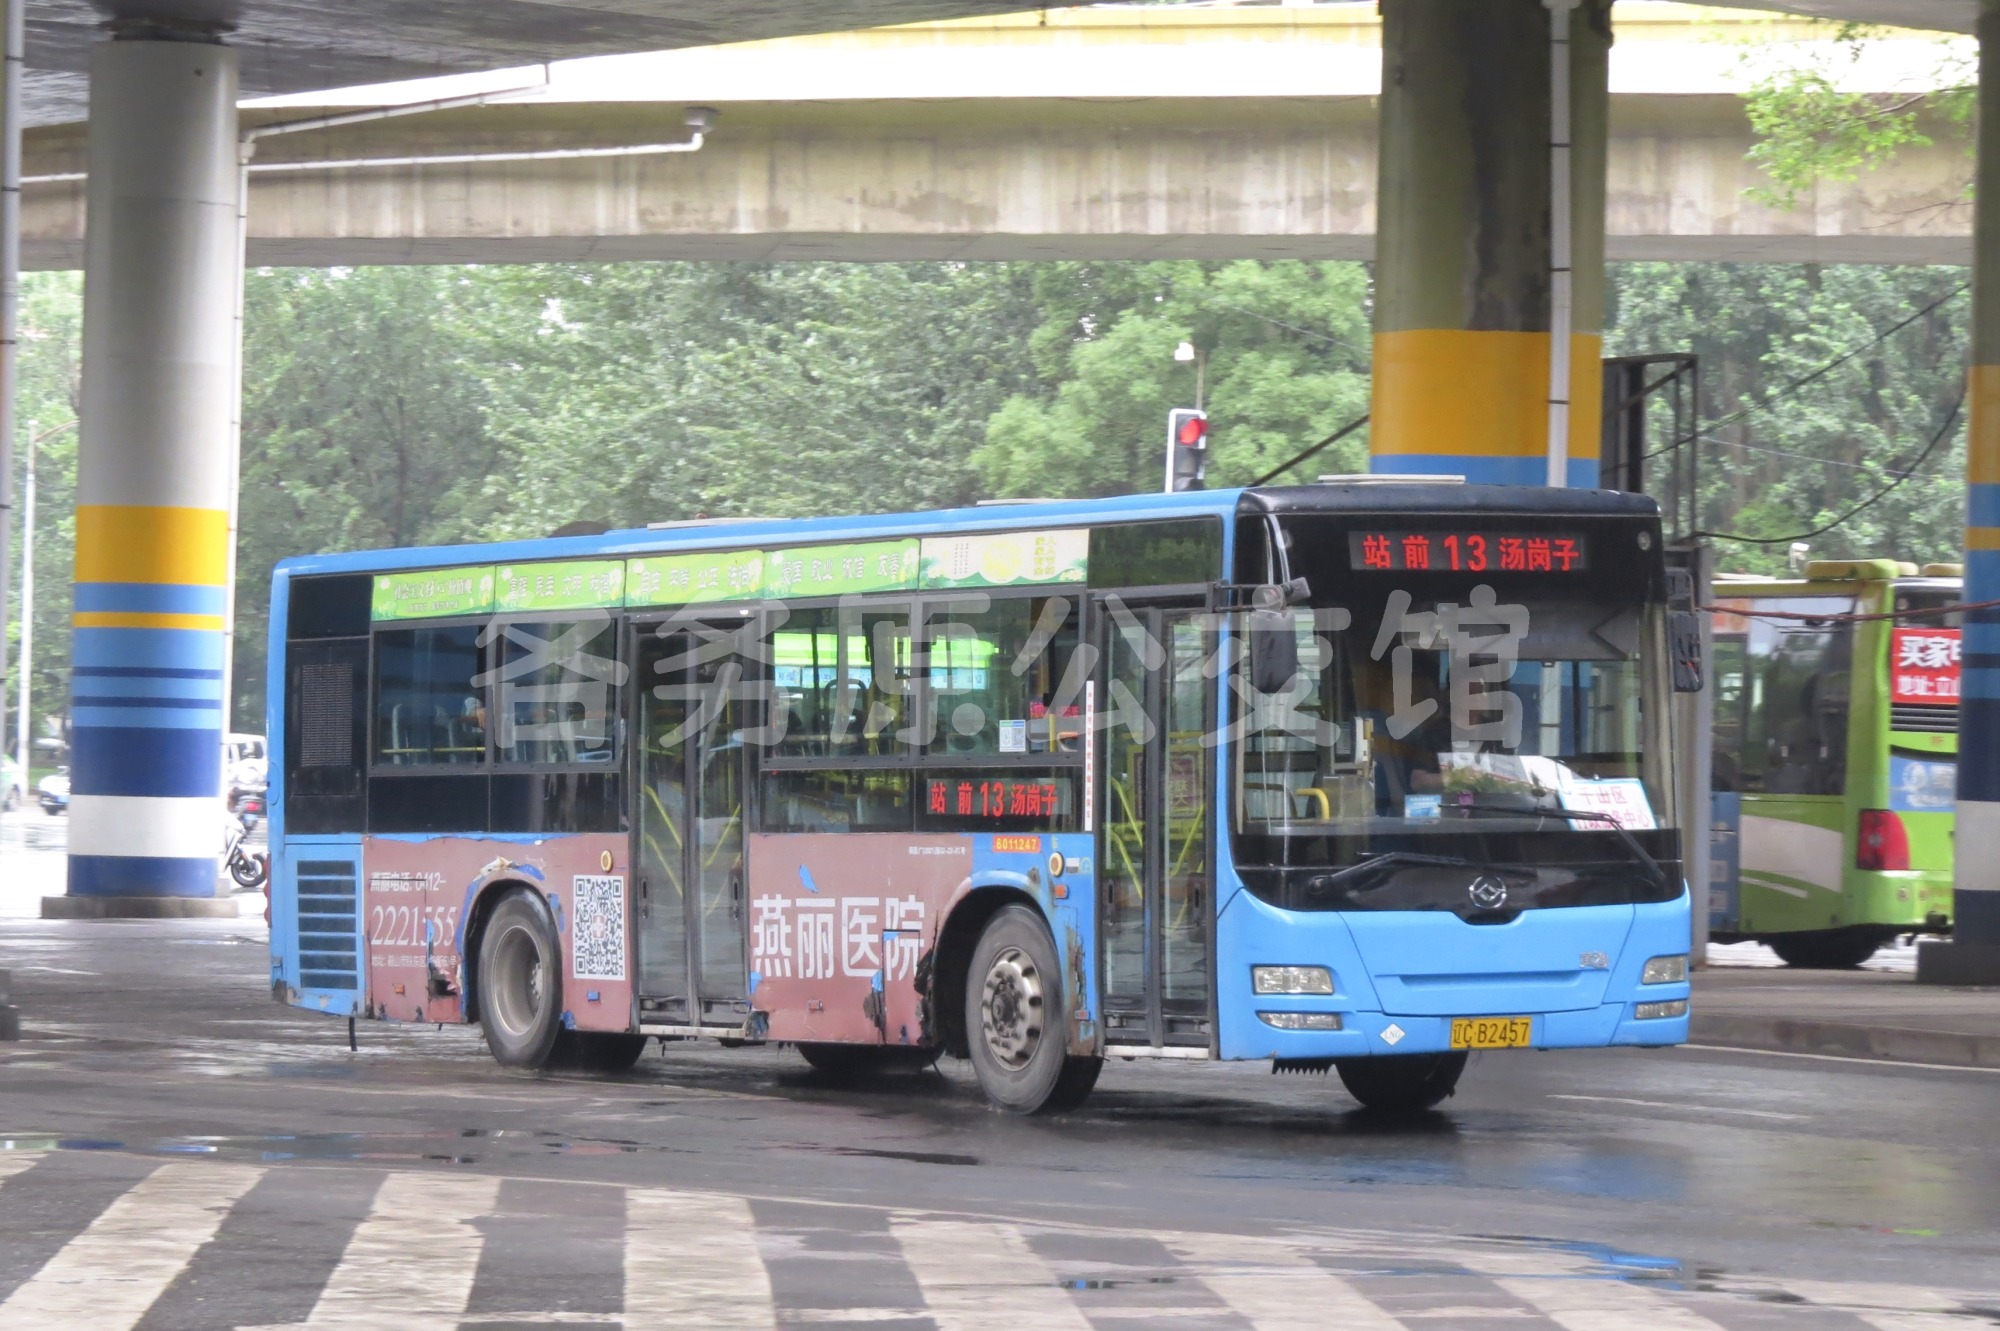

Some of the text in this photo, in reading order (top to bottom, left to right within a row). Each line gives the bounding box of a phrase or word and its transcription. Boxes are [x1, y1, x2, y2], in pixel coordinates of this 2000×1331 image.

[1363, 535, 1579, 572] 站前 13 汤岗子
[931, 781, 1059, 817] 站前 13 汤岗子
[371, 905, 457, 946] 2221555
[753, 894, 925, 981] 燕丽医院
